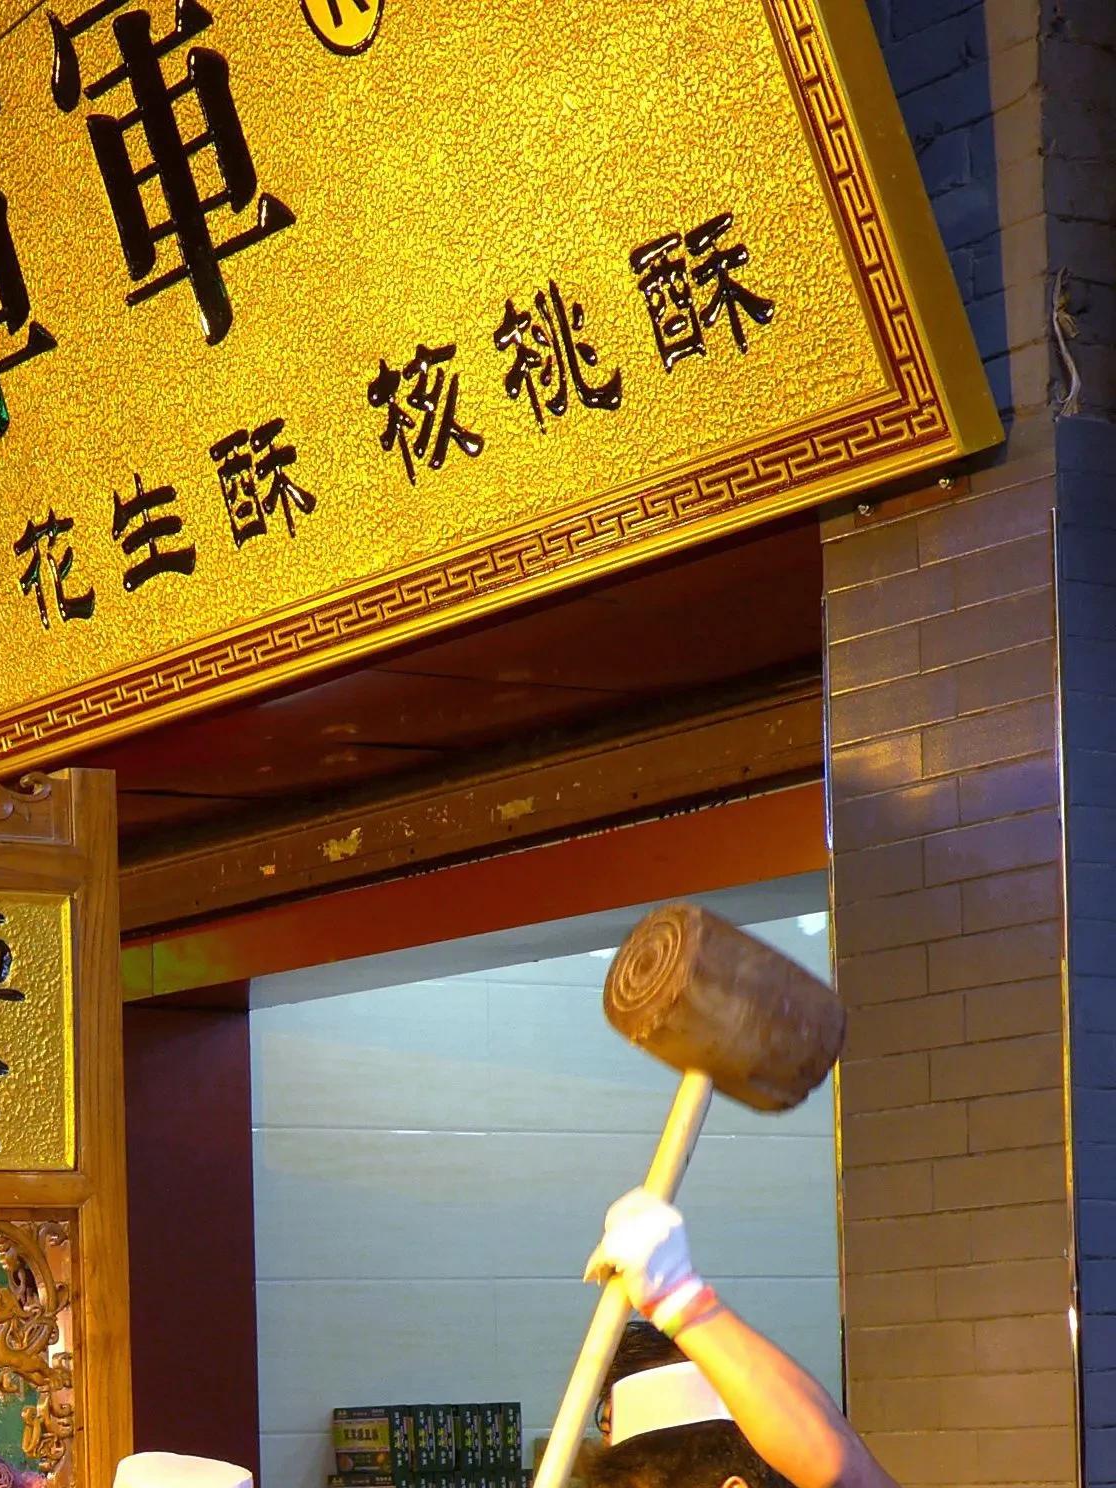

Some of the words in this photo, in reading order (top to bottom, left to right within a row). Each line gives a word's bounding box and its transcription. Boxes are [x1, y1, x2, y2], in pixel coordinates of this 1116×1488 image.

[15, 417, 316, 629] 花生酥
[367, 212, 776, 485] 核桃酥
